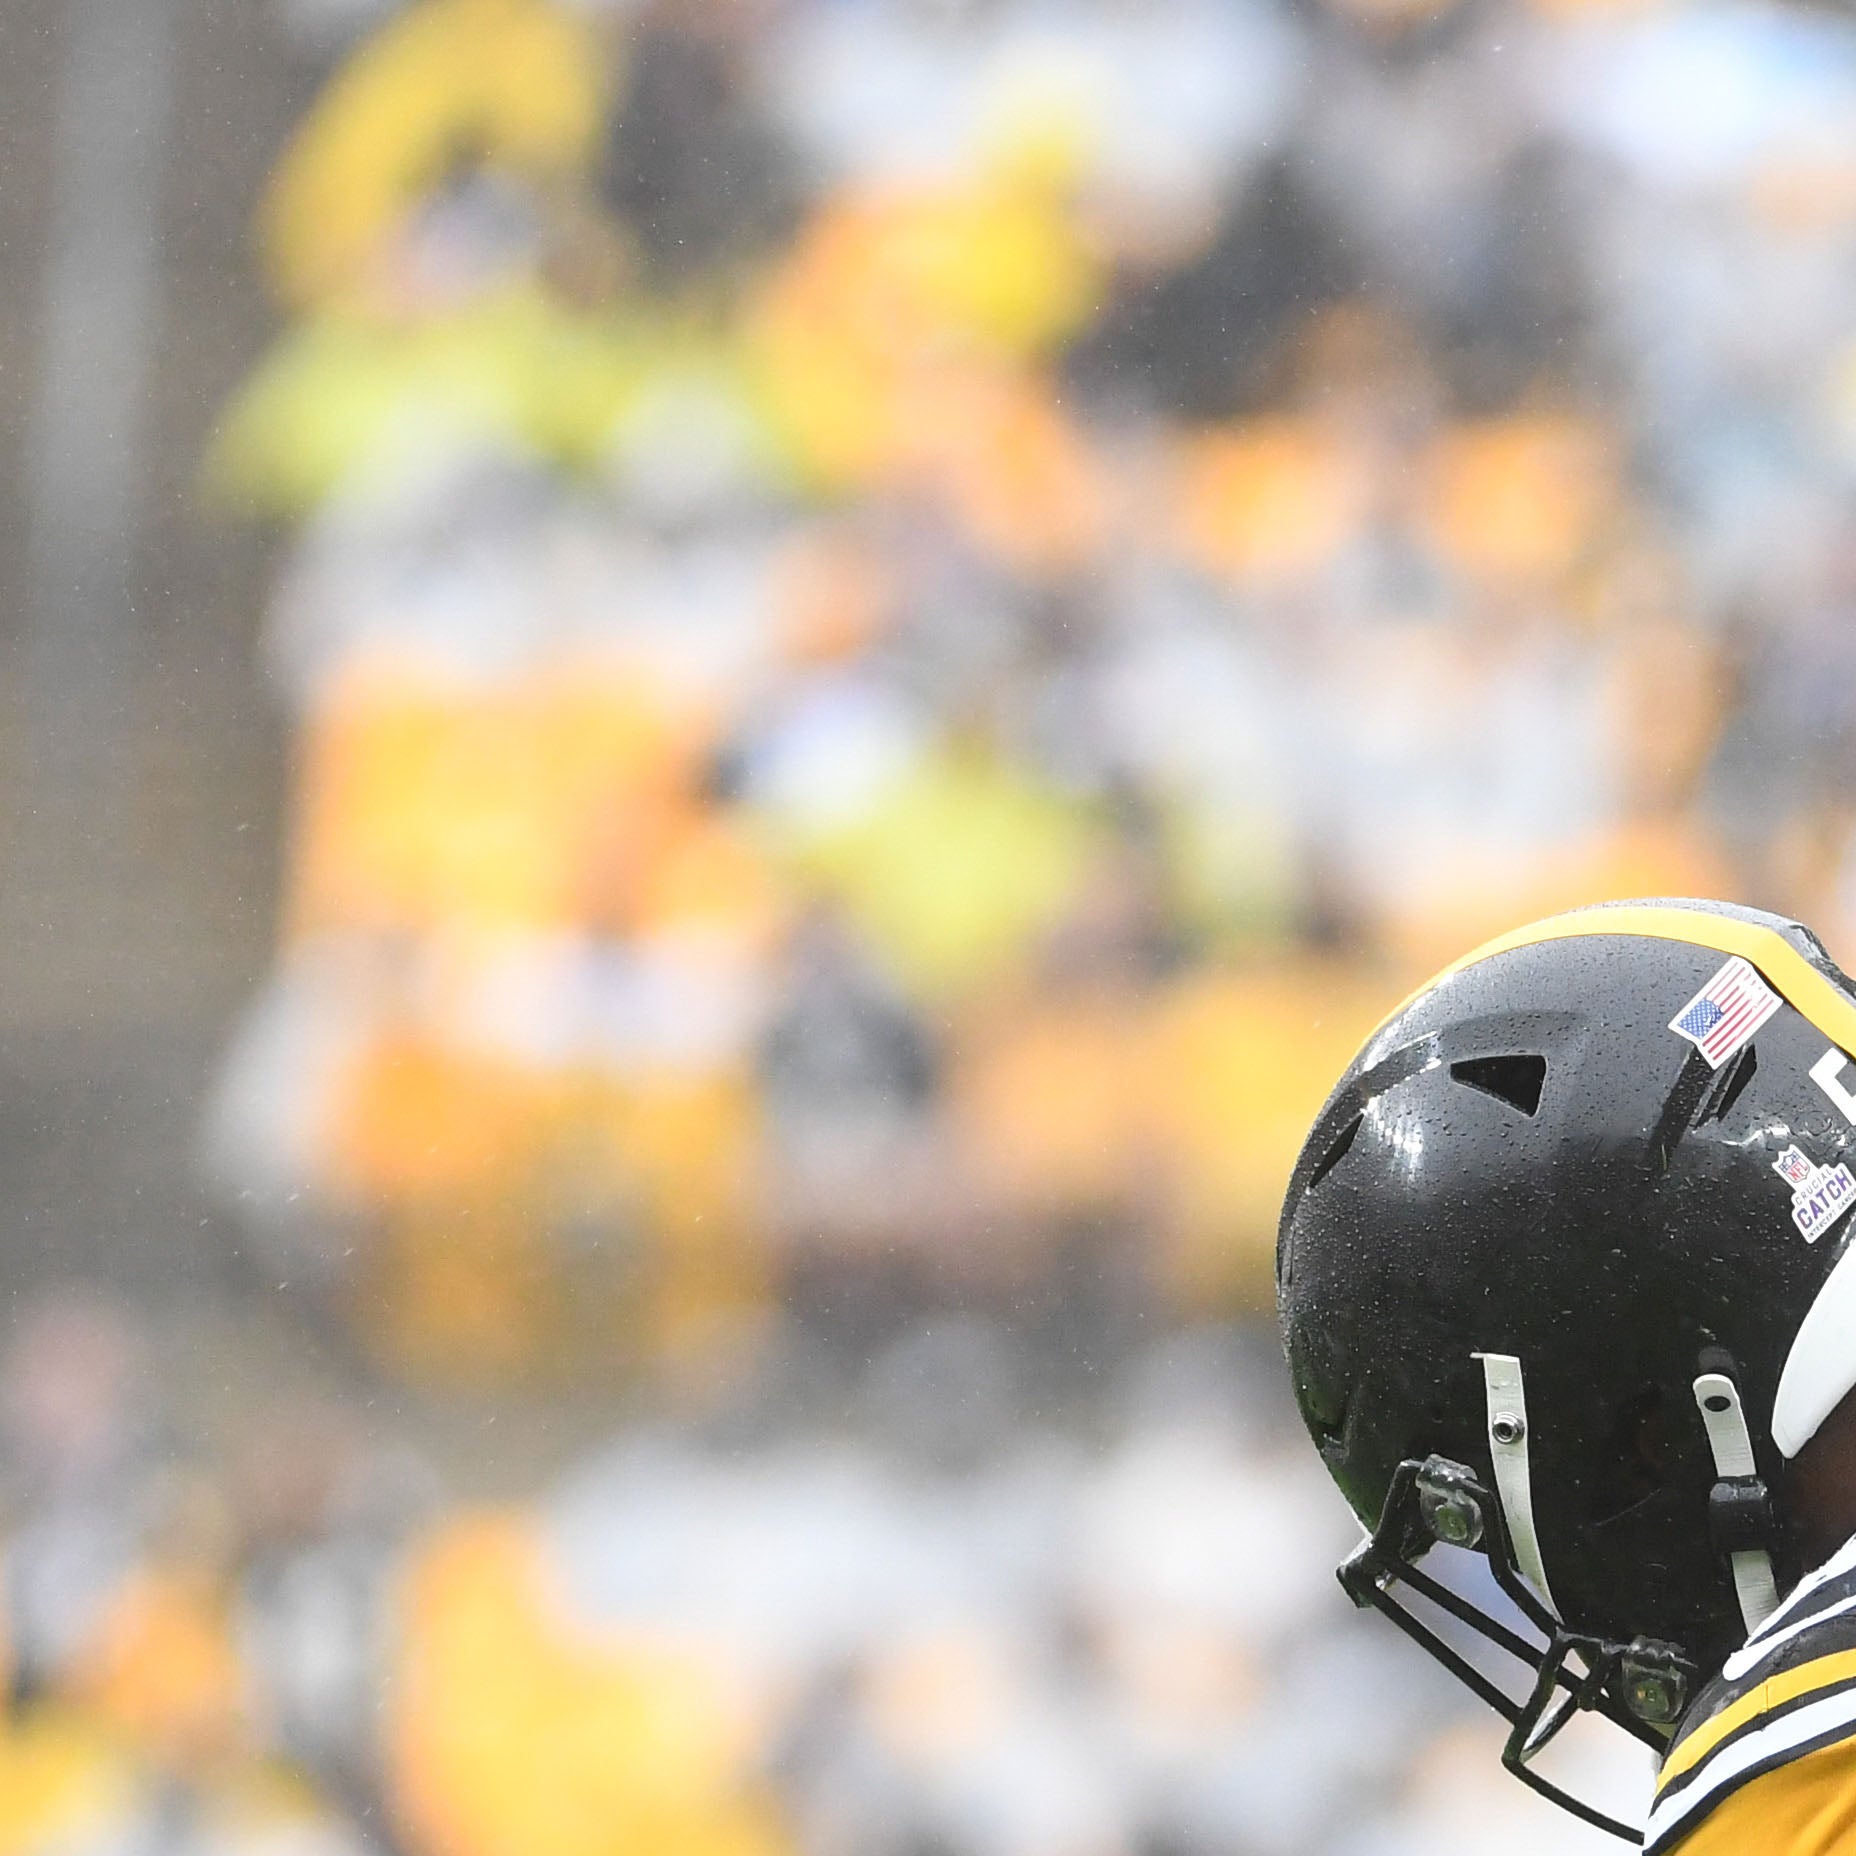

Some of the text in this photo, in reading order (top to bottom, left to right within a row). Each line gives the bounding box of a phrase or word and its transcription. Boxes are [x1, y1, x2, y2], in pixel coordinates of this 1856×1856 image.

[1787, 1161, 1809, 1181] NFL
[1795, 1168, 1833, 1206] CRUCIAL
[1796, 1168, 1852, 1230] CATCH
